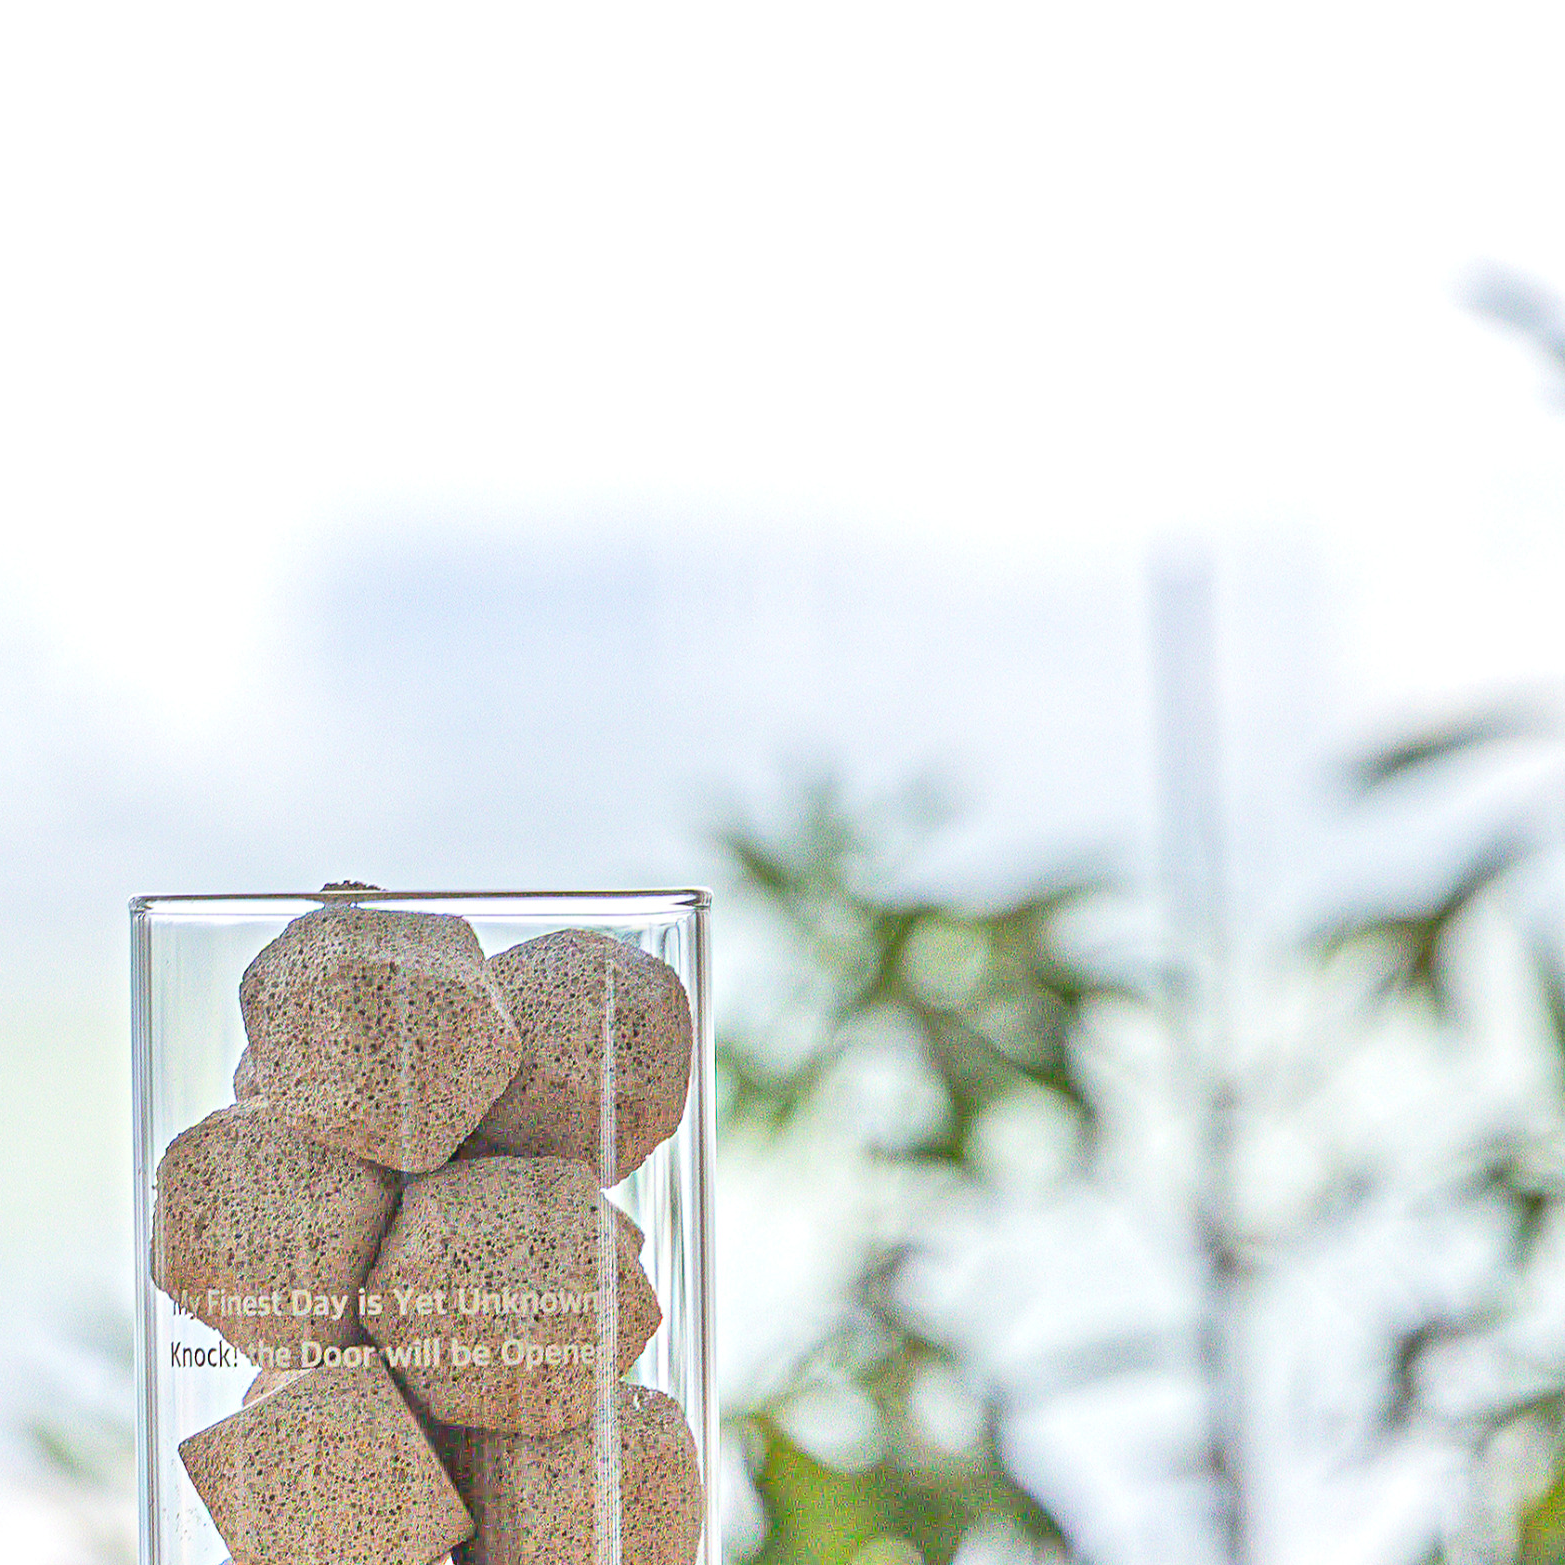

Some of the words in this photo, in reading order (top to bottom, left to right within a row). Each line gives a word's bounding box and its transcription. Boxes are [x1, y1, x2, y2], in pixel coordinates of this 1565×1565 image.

[208, 1288, 282, 1317] Finest
[292, 1289, 348, 1321] Day
[358, 1287, 383, 1317] is
[393, 1288, 447, 1317] Yet
[458, 1287, 602, 1317] Unknown
[170, 1340, 238, 1368] Knock!
[248, 1340, 293, 1369] the
[301, 1340, 381, 1369] Door
[385, 1340, 441, 1368] will
[449, 1338, 491, 1367] be
